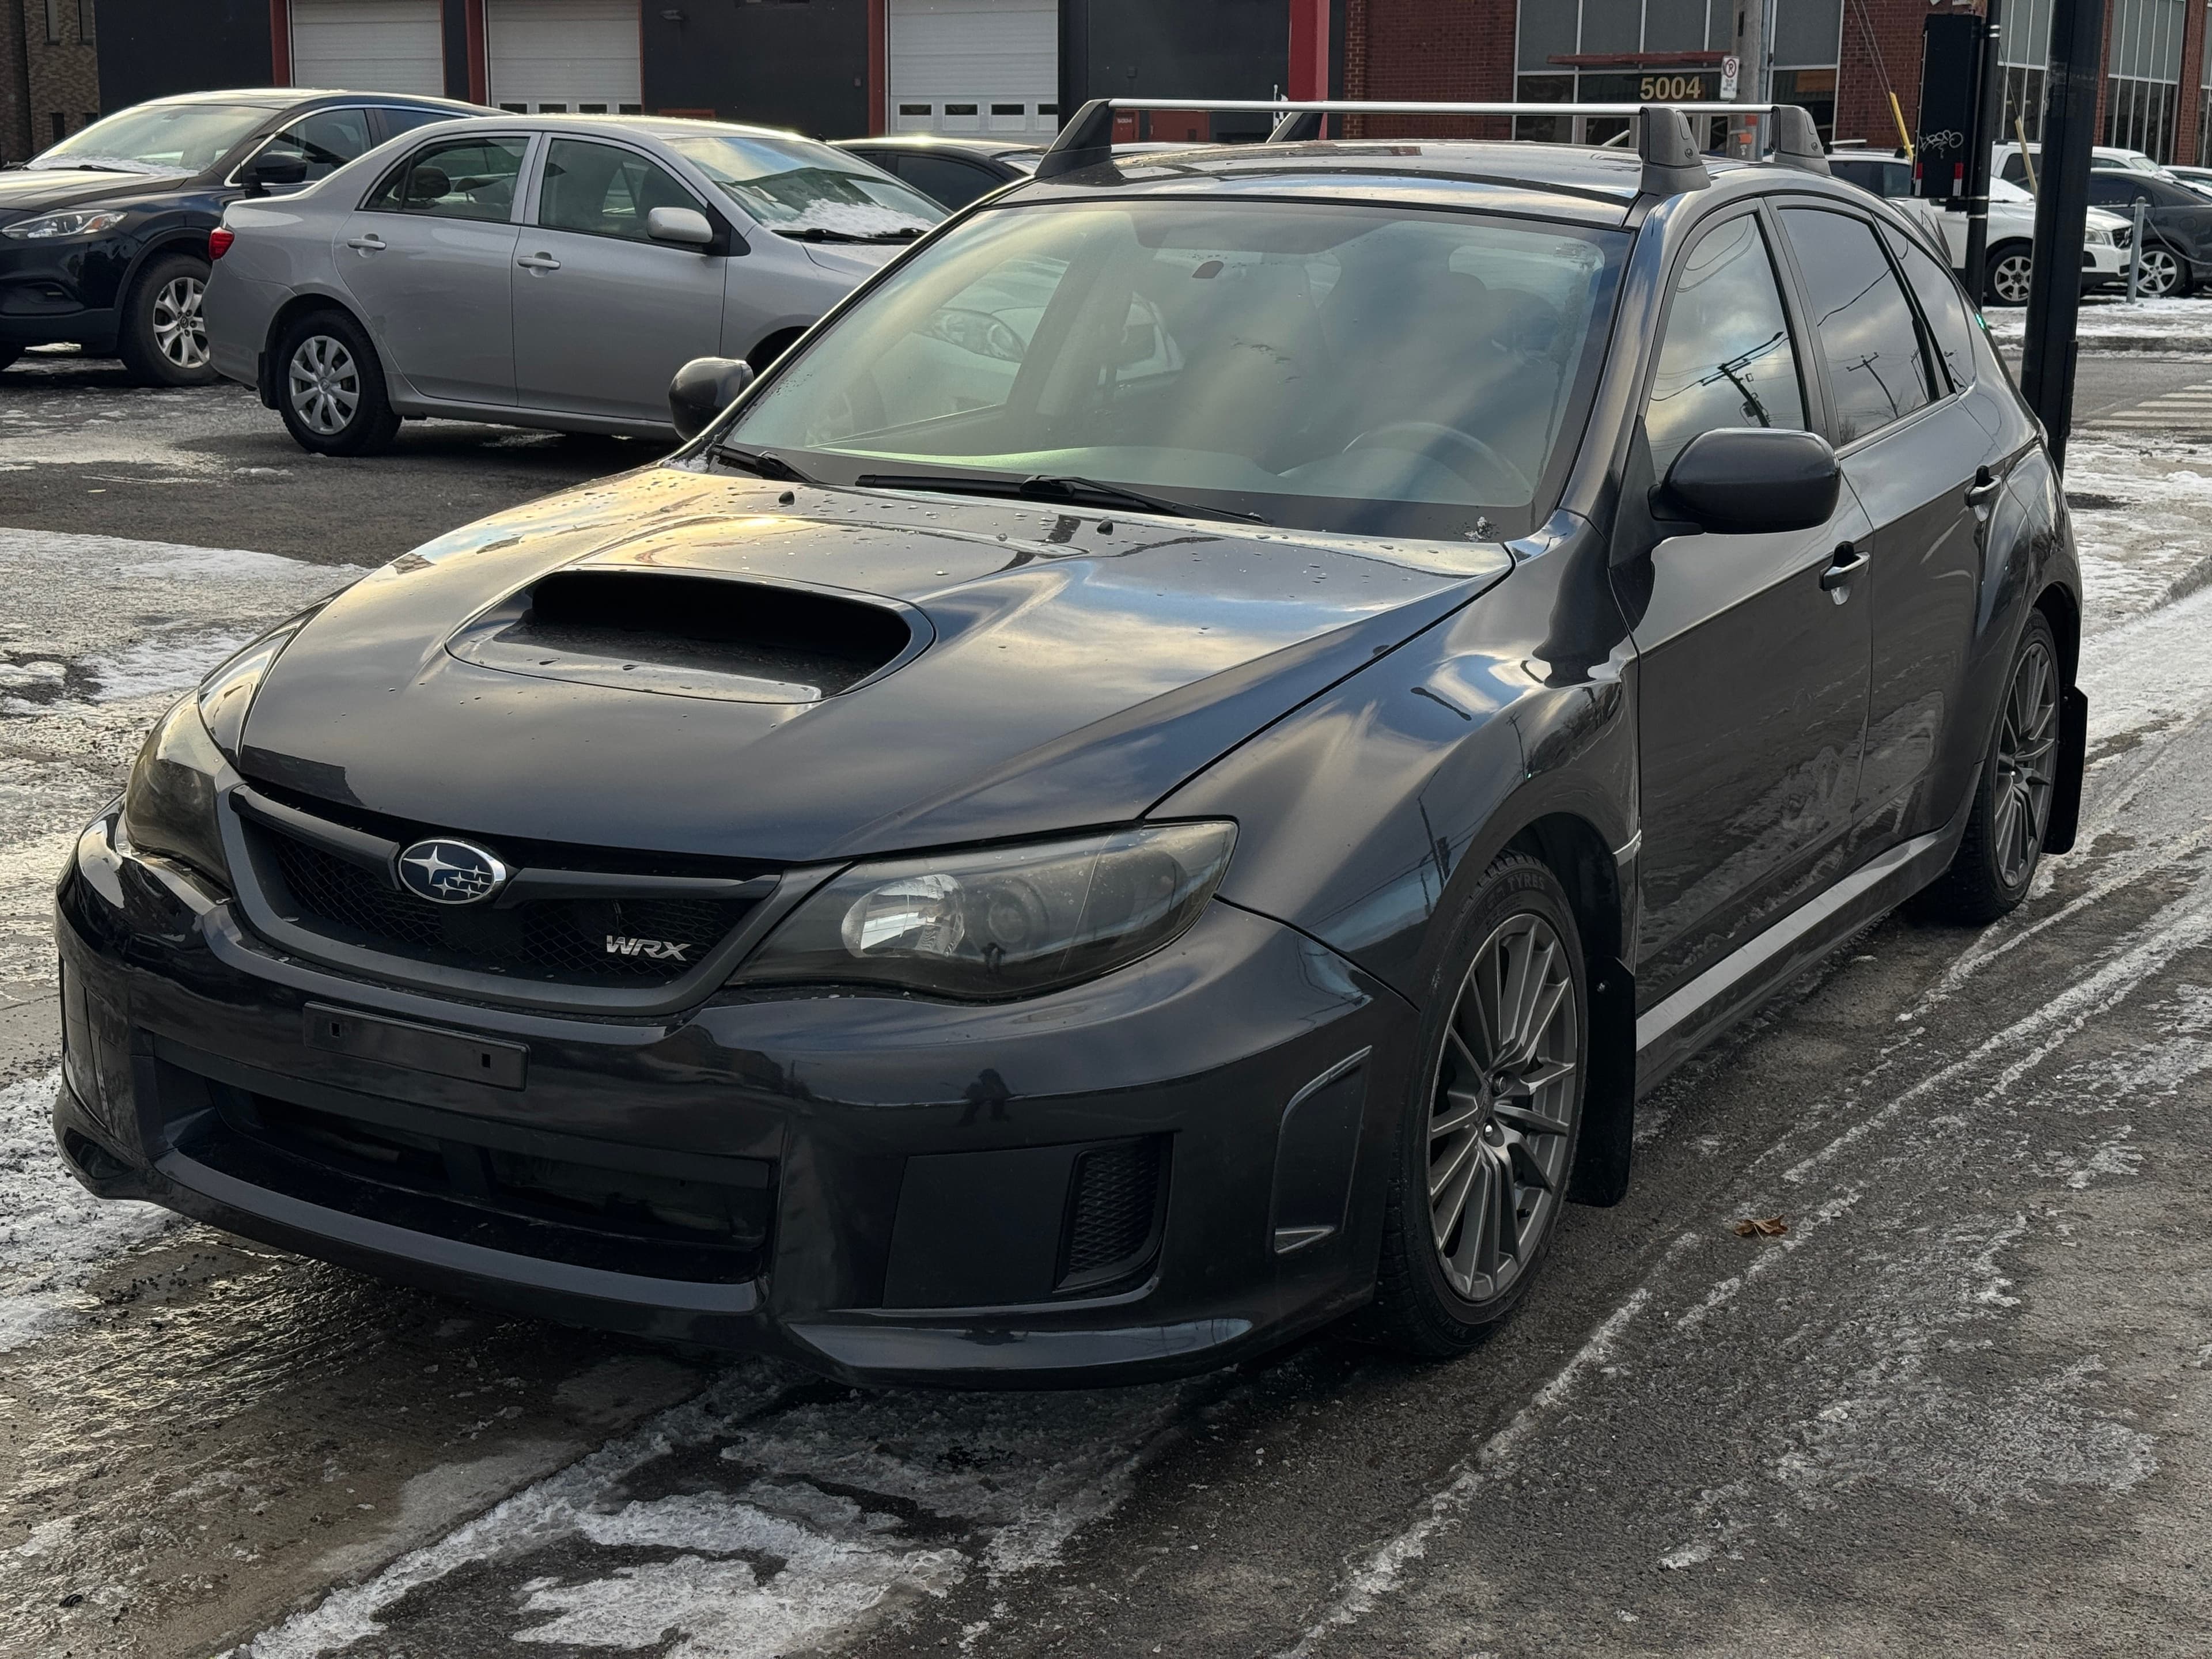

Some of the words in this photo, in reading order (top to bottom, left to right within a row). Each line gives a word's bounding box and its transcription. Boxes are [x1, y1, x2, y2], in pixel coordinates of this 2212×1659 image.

[1640, 75, 1701, 100] 5004
[1507, 873, 1545, 891] TYRES
[606, 935, 692, 961] WRX
